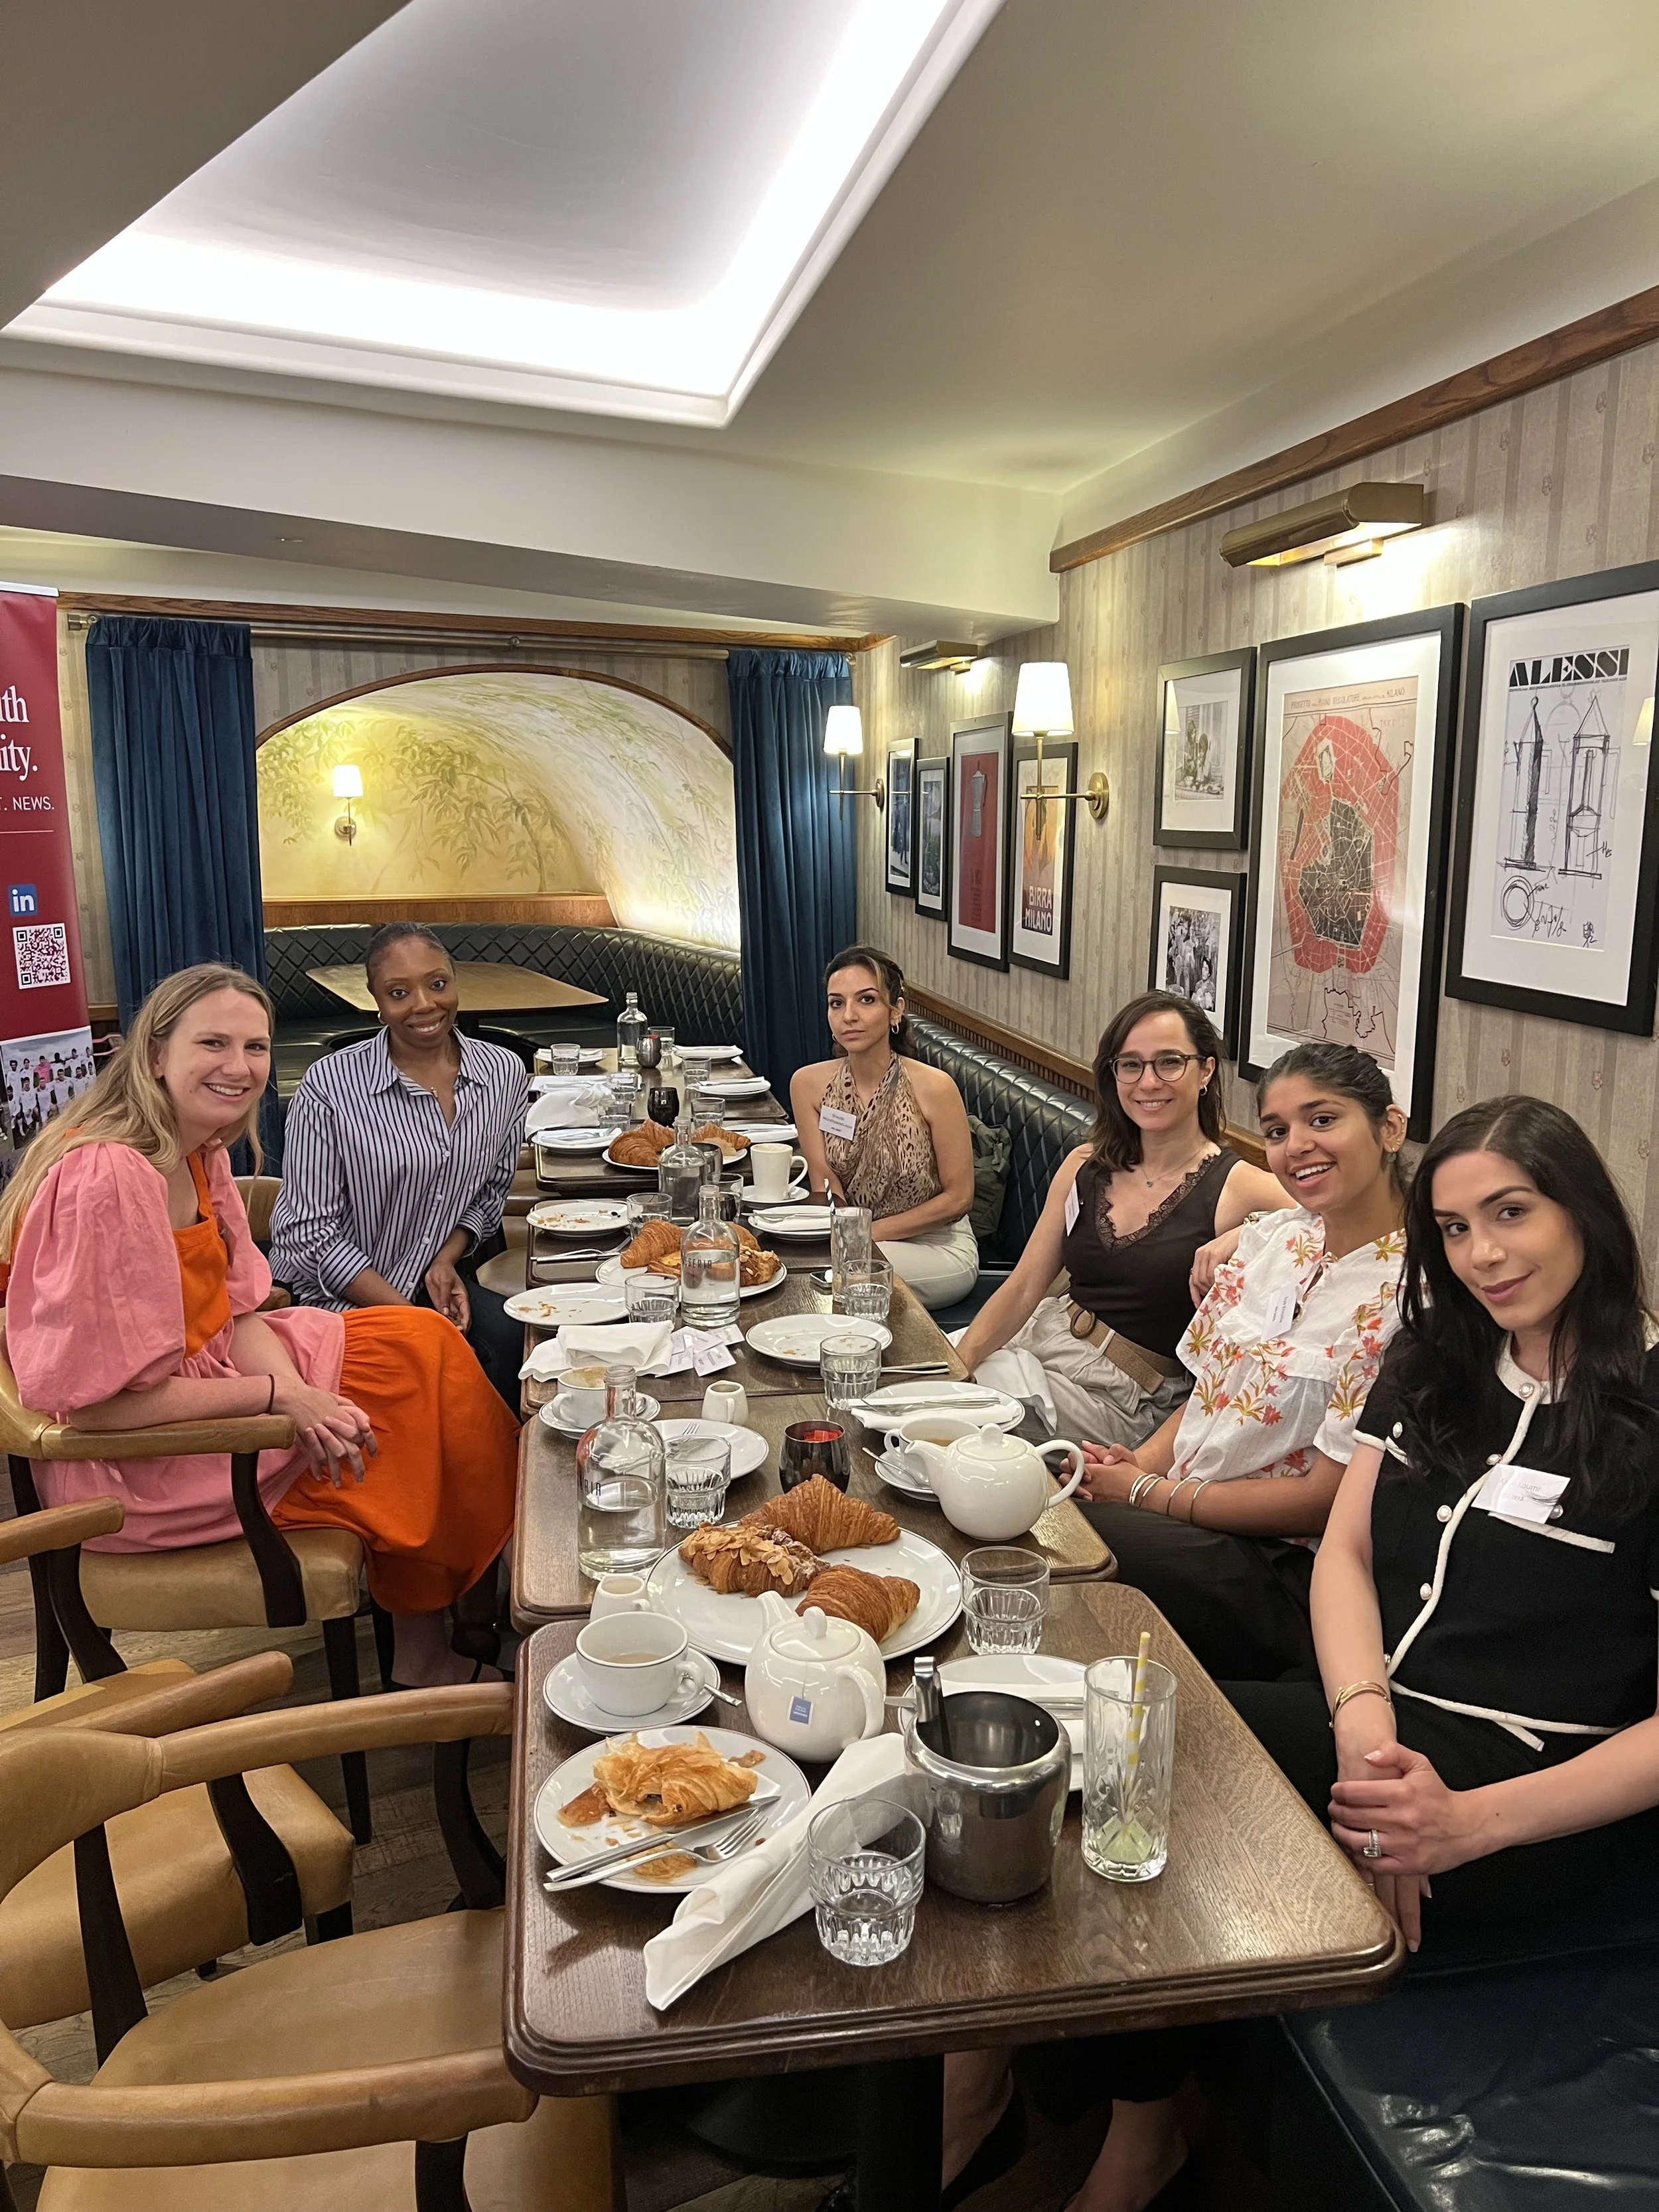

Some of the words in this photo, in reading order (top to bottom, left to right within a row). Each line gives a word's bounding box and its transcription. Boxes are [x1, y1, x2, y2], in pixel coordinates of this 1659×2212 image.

[1509, 648, 1630, 687] ALESSI
[13, 796, 54, 810] NEWS.
[12, 889, 35, 913] in
[1029, 885, 1052, 910] BIRRA
[1025, 907, 1052, 932] MILANO
